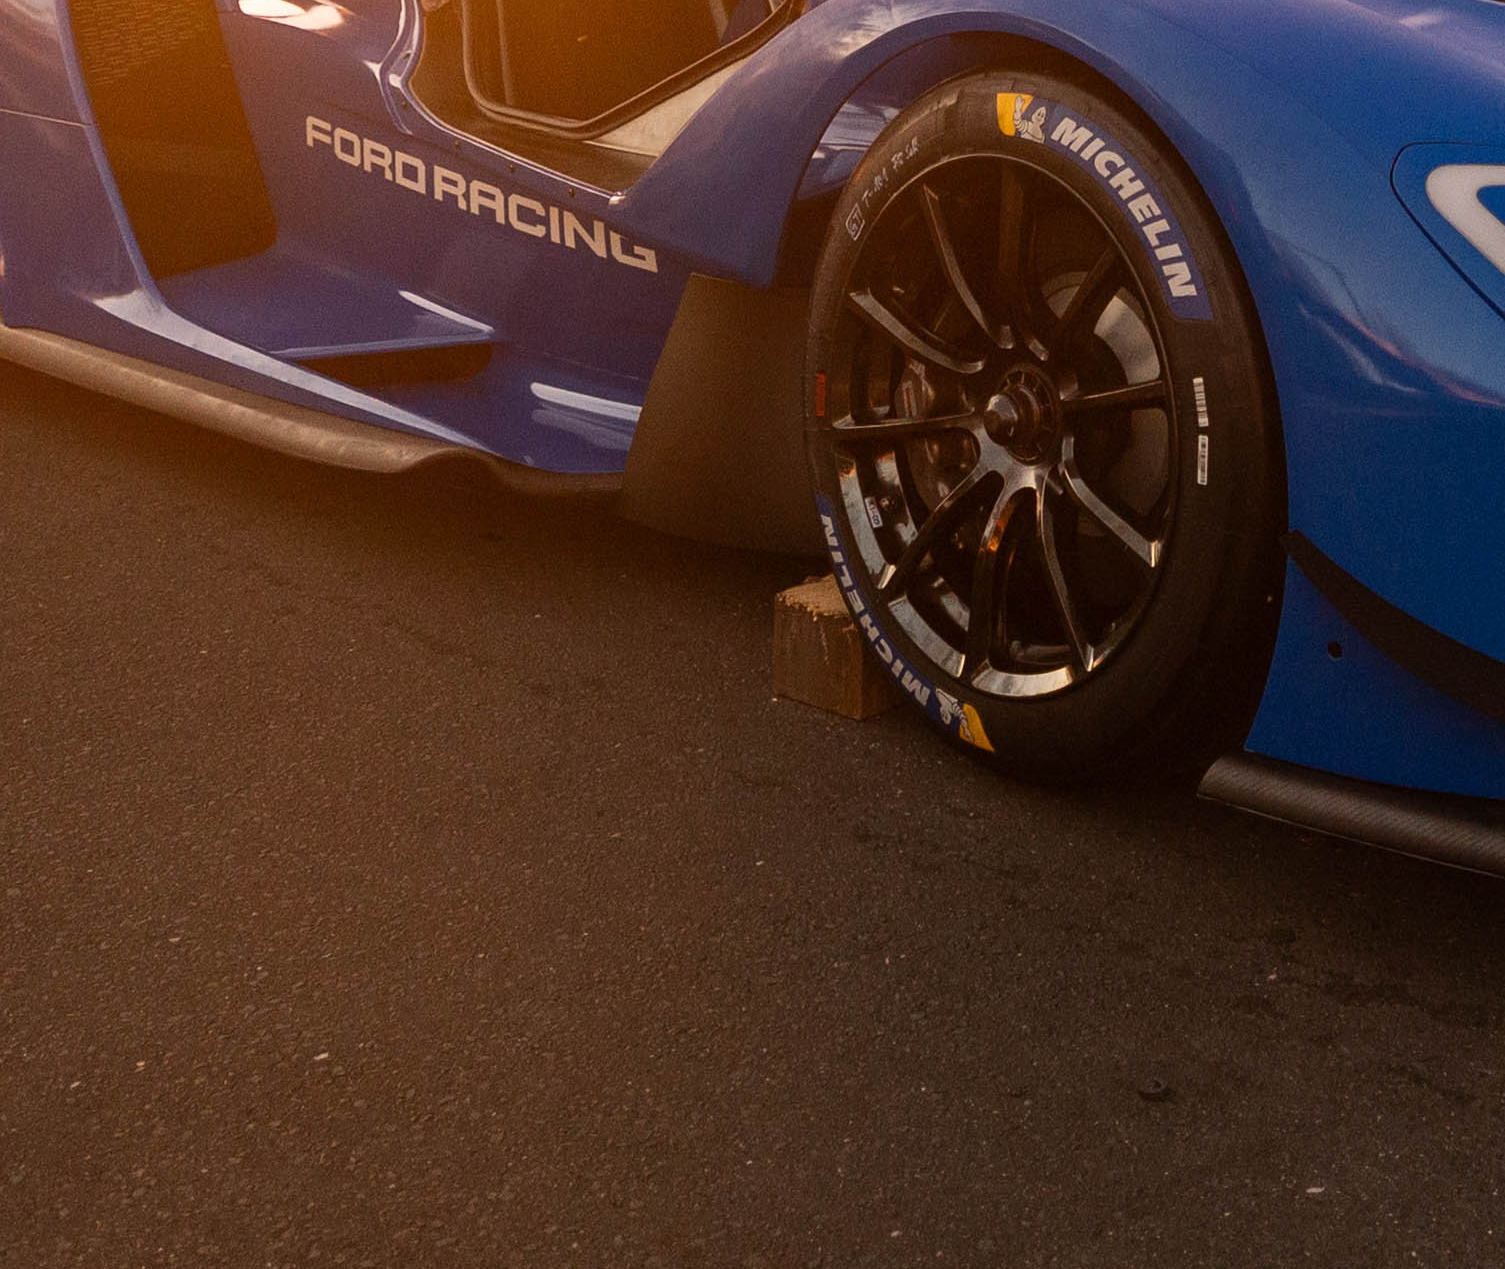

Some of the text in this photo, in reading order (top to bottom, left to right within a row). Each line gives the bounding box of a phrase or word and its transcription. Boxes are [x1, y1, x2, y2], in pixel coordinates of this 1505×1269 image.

[305, 115, 659, 274] FORD RACING
[1050, 116, 1198, 298] MICHELIN
[820, 513, 932, 707] MICHELIN
